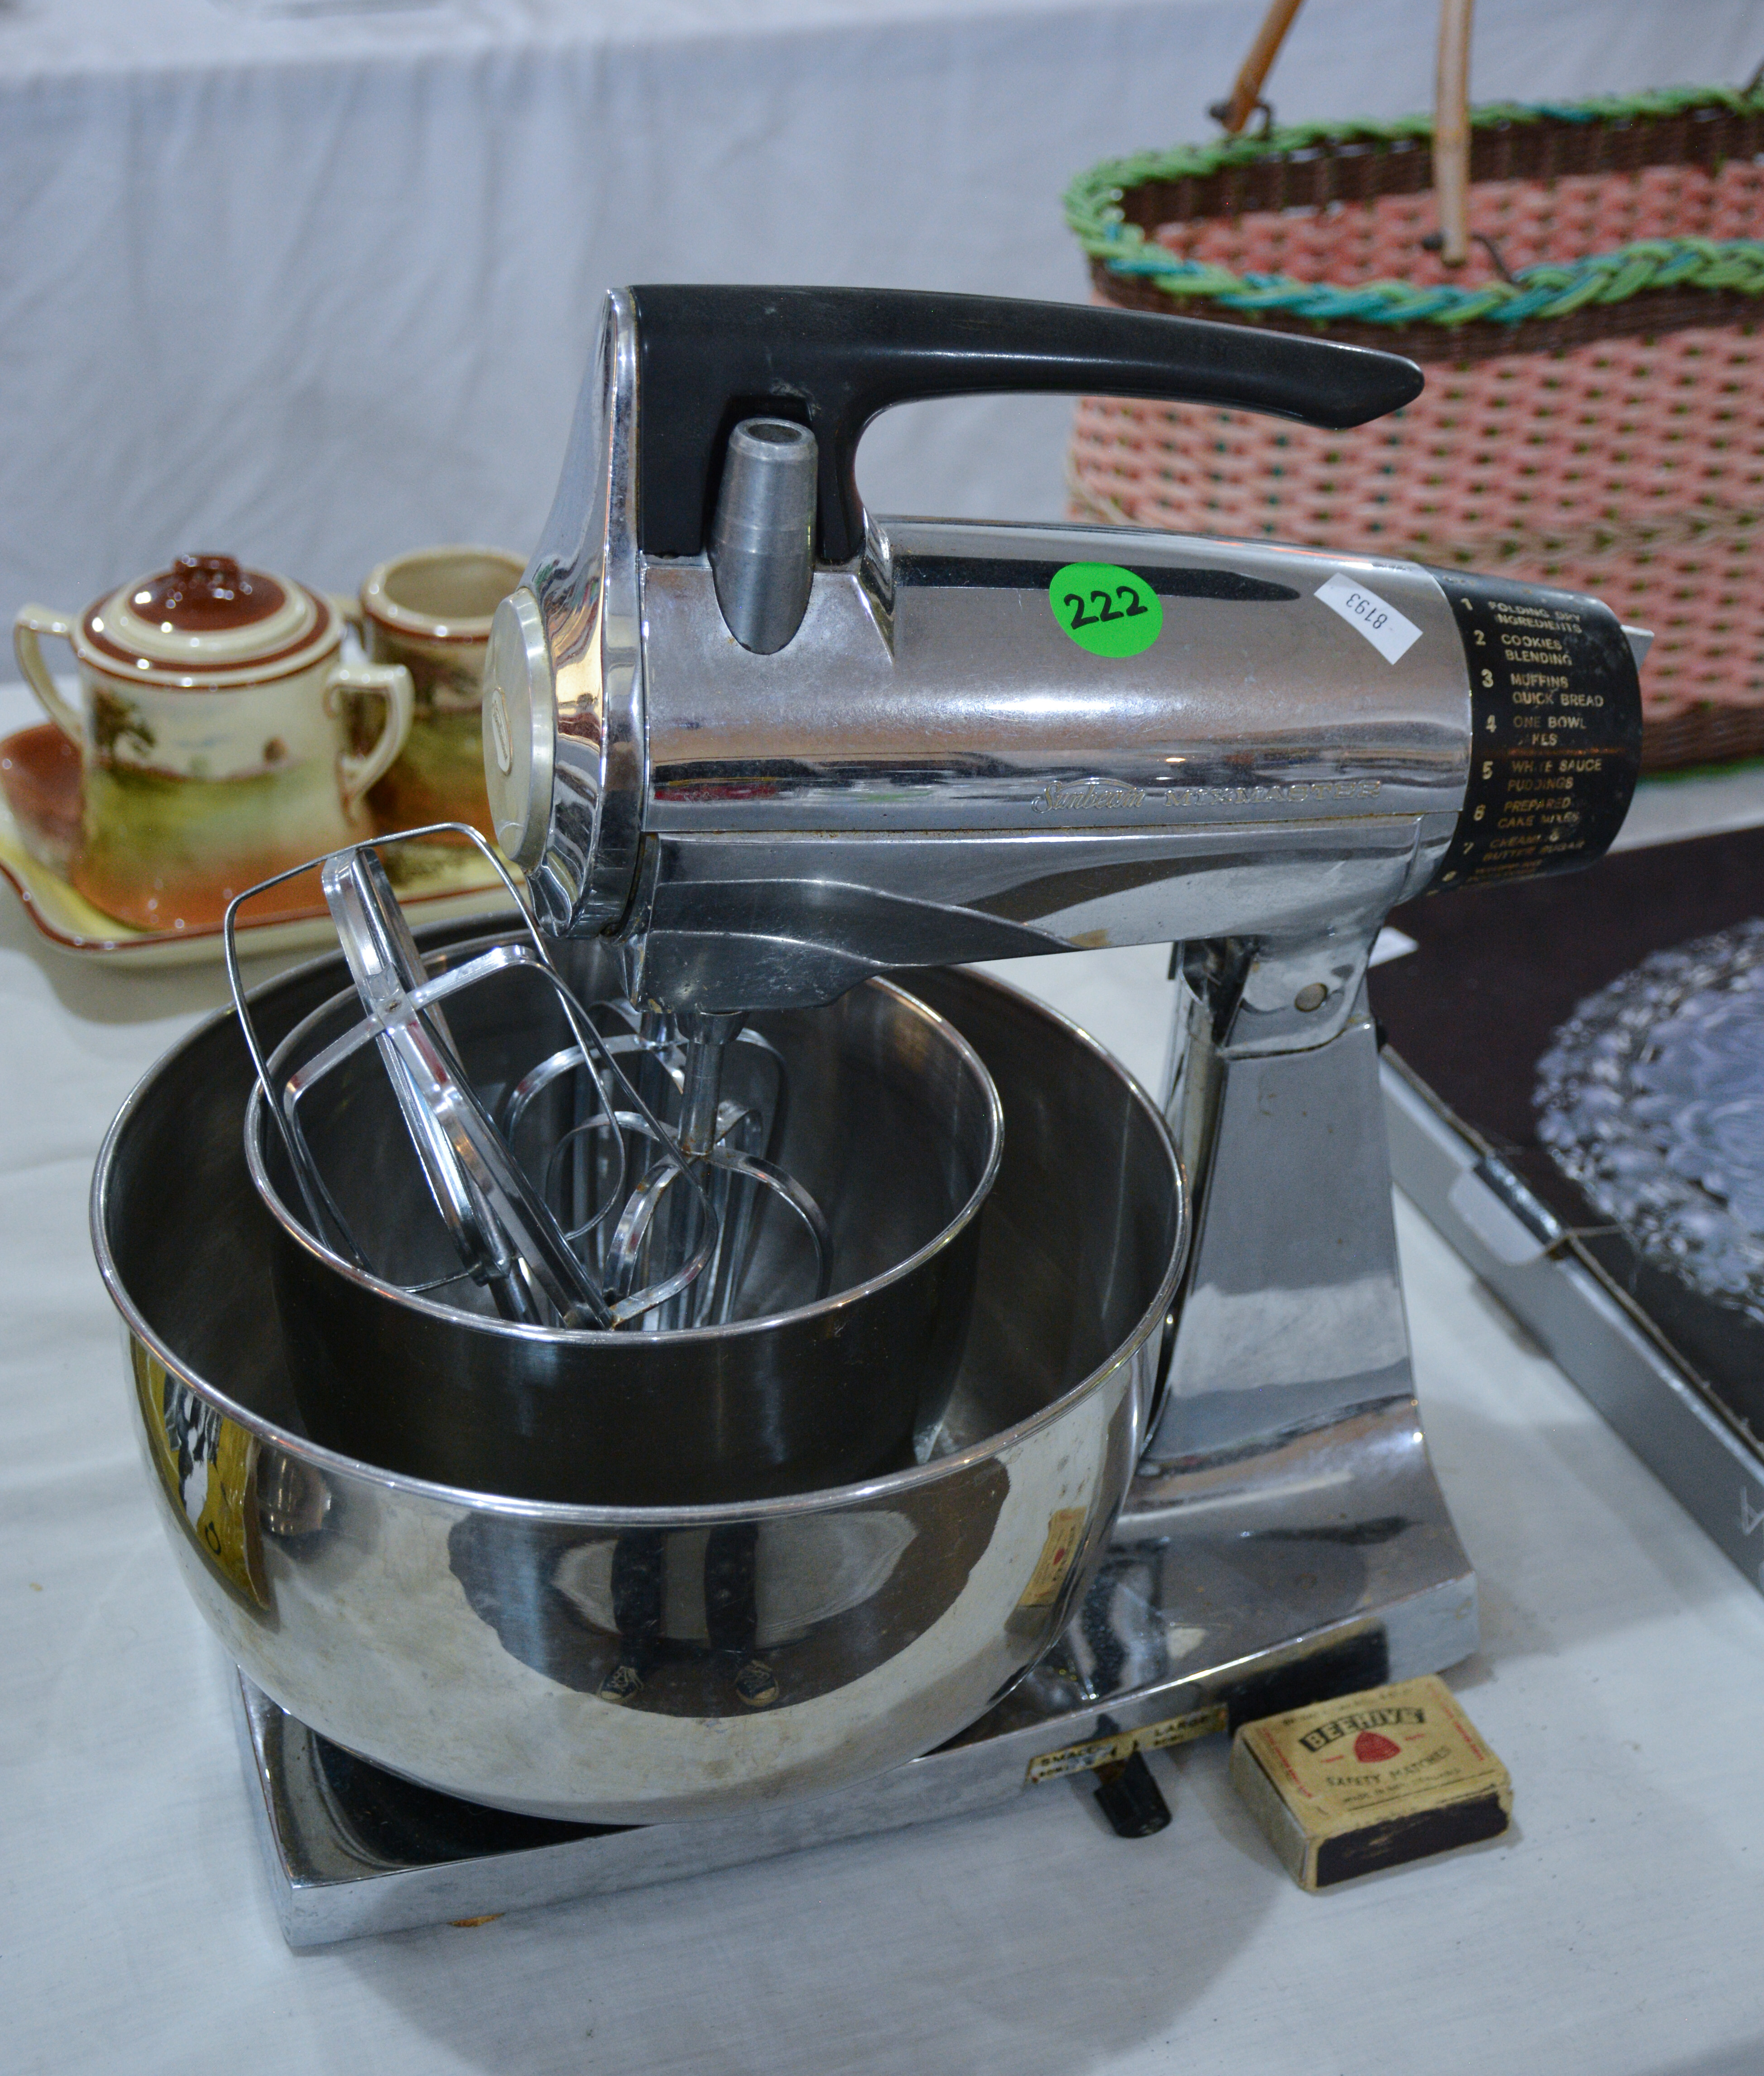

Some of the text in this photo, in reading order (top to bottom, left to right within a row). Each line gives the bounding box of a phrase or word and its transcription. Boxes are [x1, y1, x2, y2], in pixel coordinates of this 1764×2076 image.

[1063, 586, 1149, 630] 222
[1346, 593, 1388, 629] 8193
[1461, 598, 1473, 610] 1
[1474, 630, 1562, 651] 2 COOKIES
[1504, 649, 1572, 666] BLENDING
[1481, 668, 1569, 689] 3 MUFFINS
[1512, 691, 1604, 707] QUICK BREAD
[1485, 714, 1587, 733] 4 ONE BOWL
[1482, 758, 1603, 780] 5 WHE SAUCE
[1031, 777, 1381, 814] Sunbeam MIXMASTER
[1473, 797, 1572, 821] 6 PREPARED
[1498, 815, 1536, 829] CAKE
